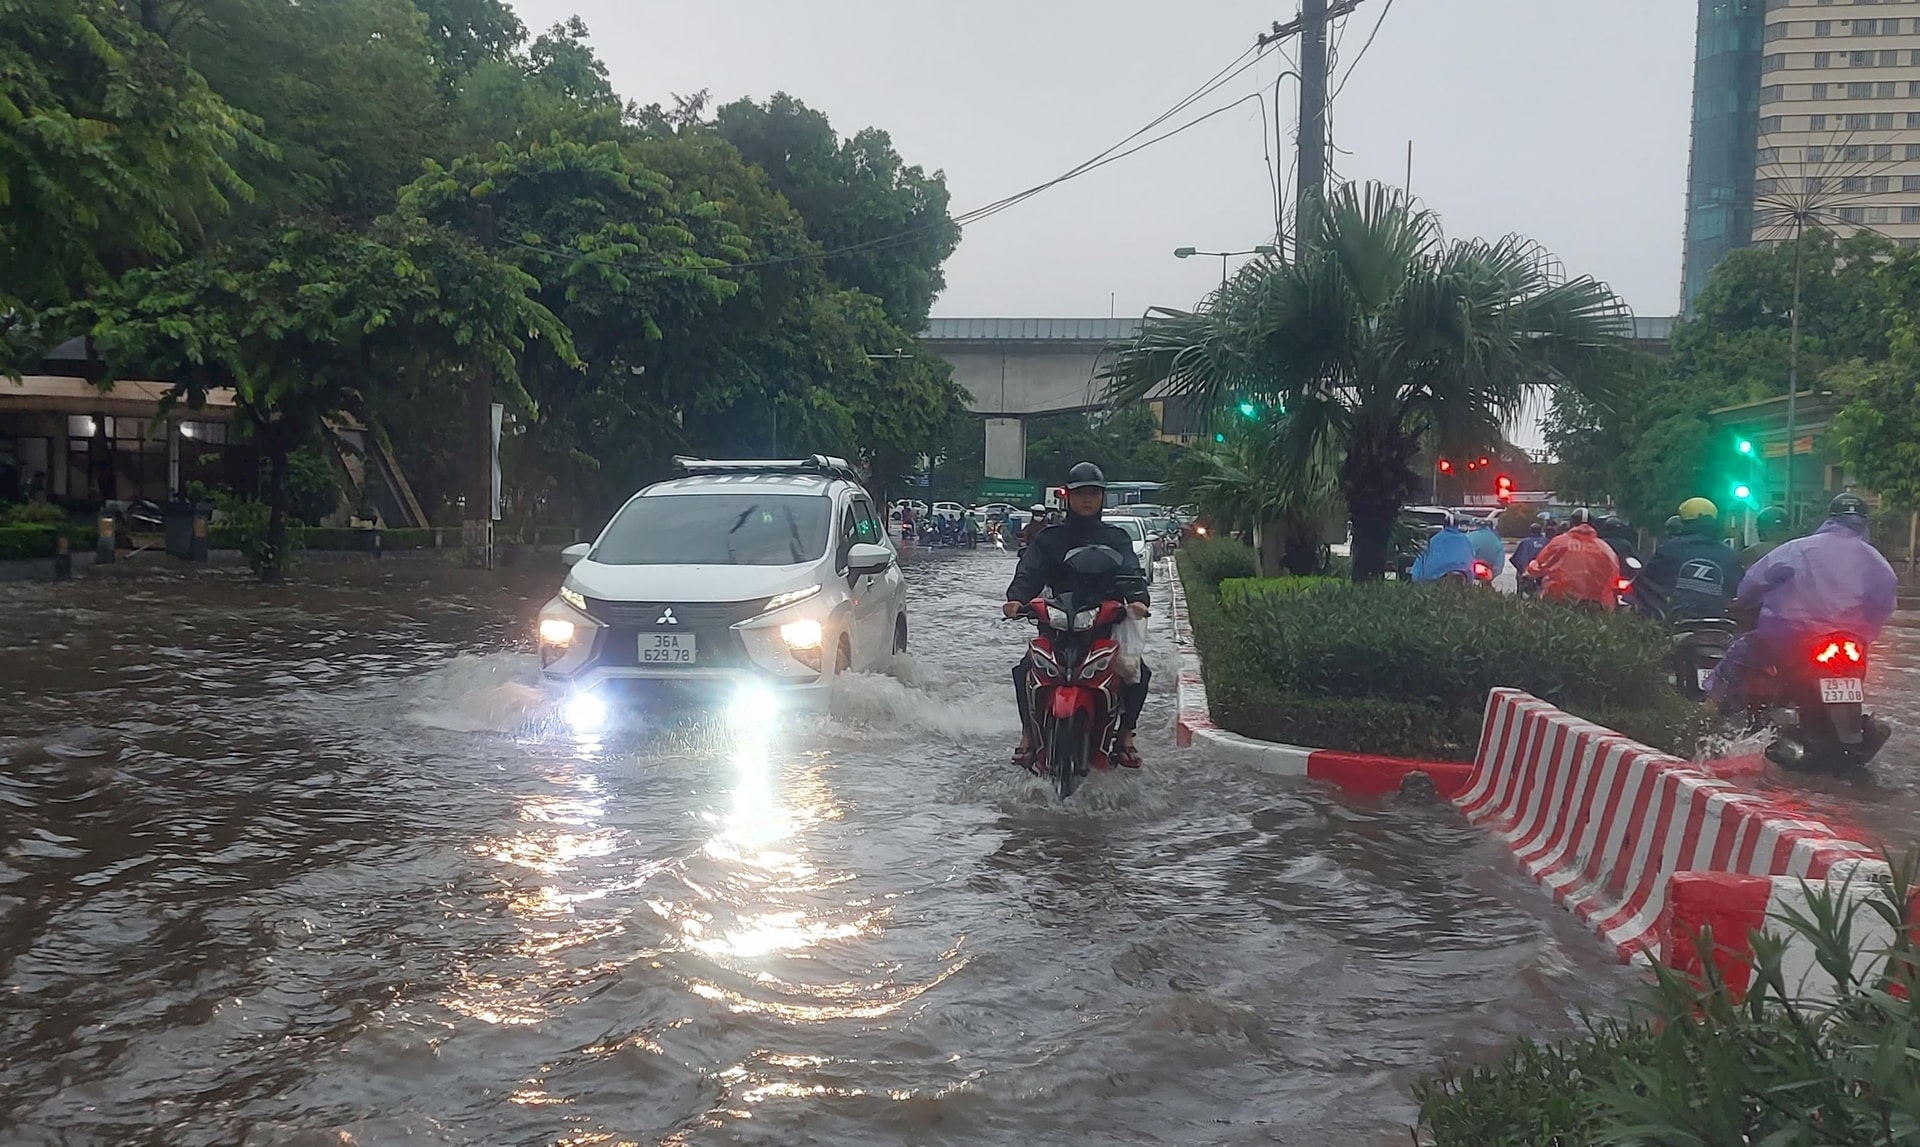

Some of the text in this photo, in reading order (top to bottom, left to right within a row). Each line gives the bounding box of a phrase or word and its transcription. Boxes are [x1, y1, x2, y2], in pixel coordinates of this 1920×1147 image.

[654, 635, 679, 648] 36A
[644, 649, 690, 661] 629.78
[1824, 691, 1862, 702] 237.08
